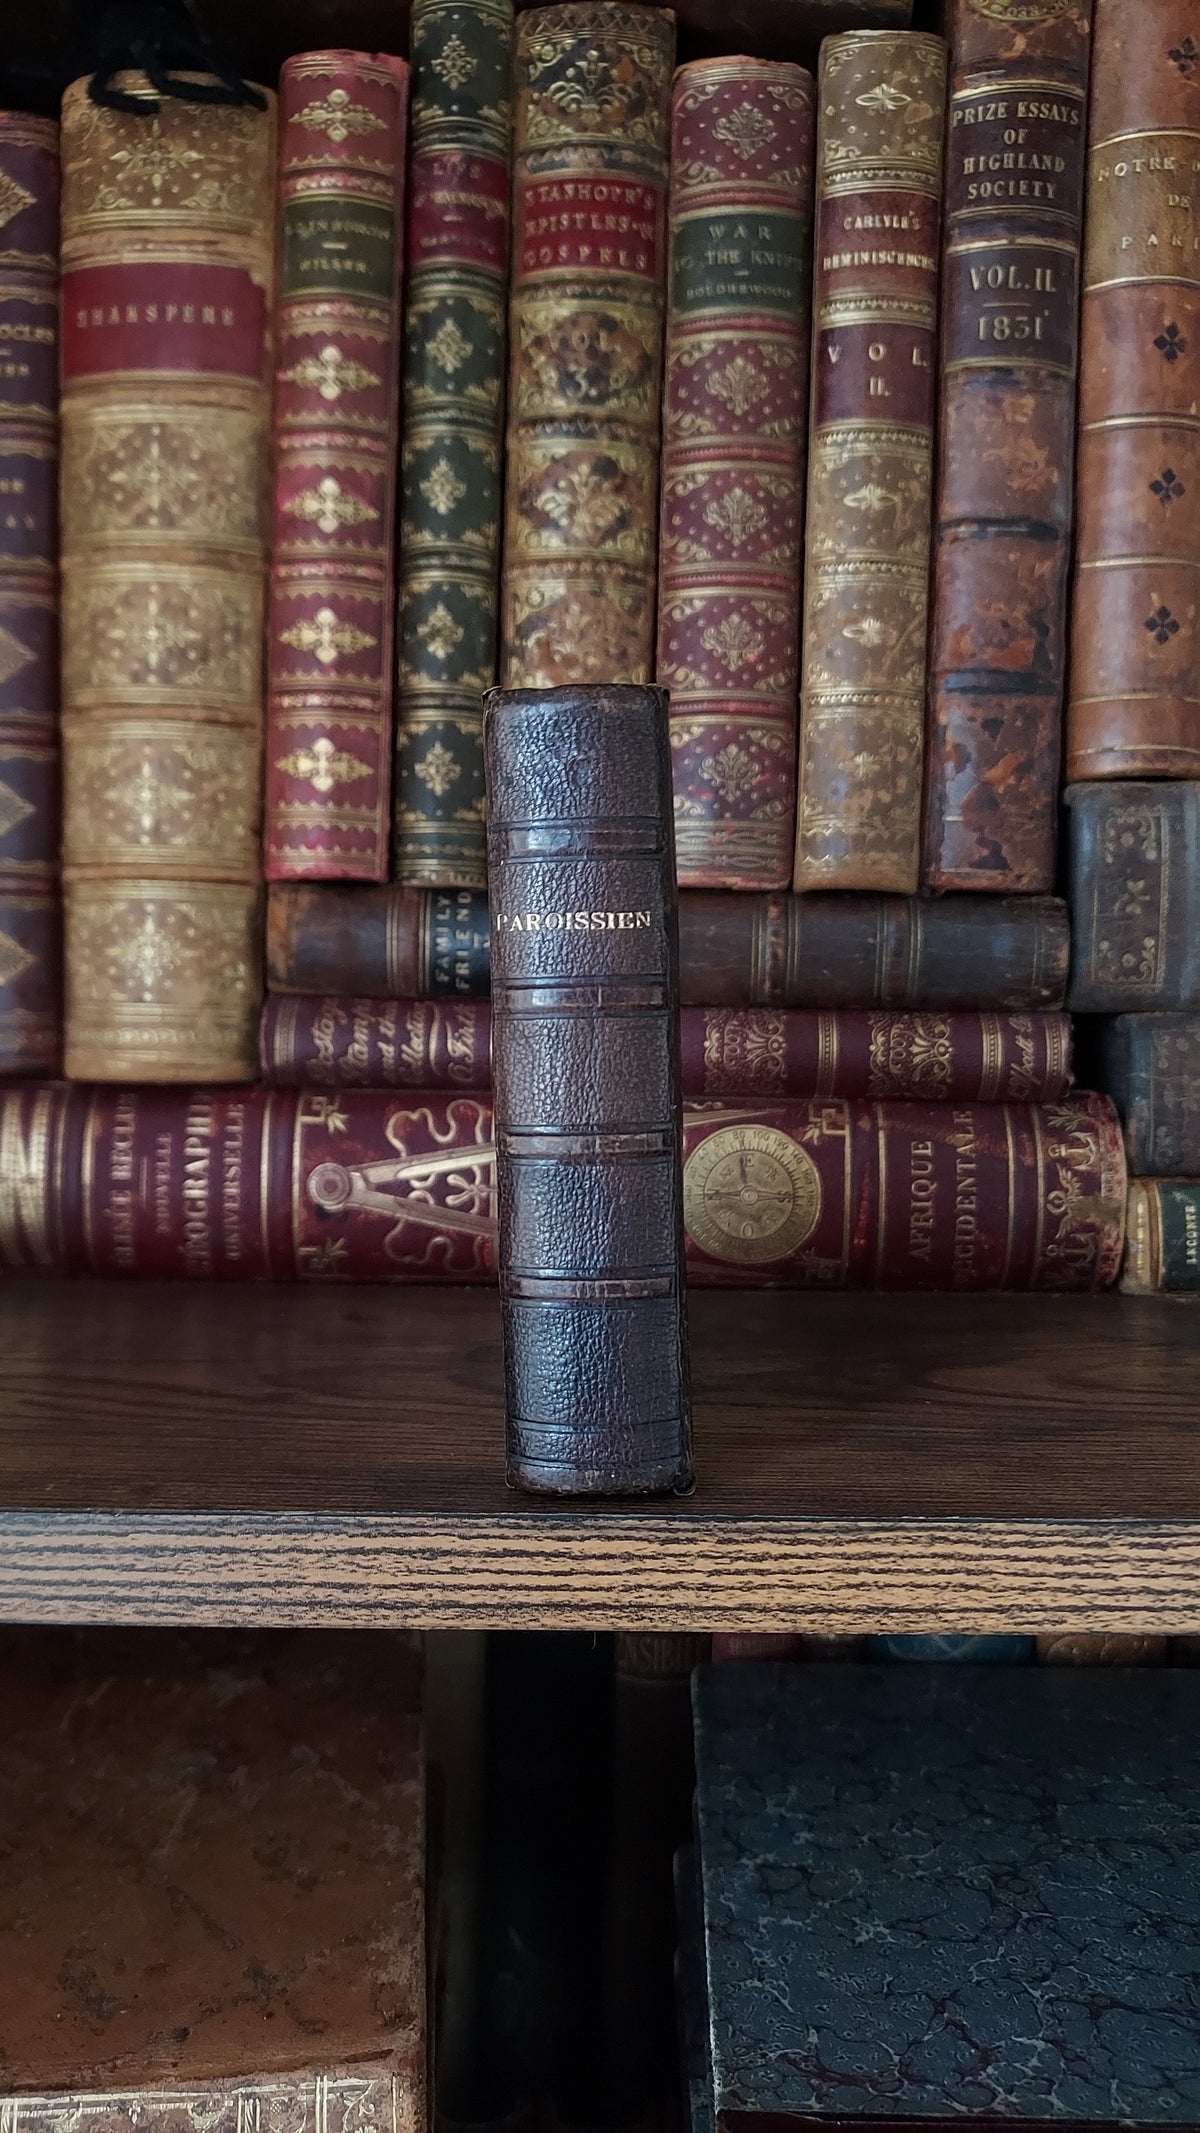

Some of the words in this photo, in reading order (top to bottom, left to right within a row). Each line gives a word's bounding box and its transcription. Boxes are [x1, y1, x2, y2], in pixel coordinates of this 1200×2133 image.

[952, 102, 1008, 128] PRIZE
[1017, 101, 1079, 126] ESSAYS
[1003, 128, 1028, 145] OF
[962, 152, 1065, 175] HIGHLAND
[967, 179, 1057, 200] SOCIETY
[1168, 194, 1191, 208] DE
[843, 211, 921, 231] CARLYLE'S
[708, 223, 770, 241] WAR
[704, 248, 741, 265] THE
[823, 251, 936, 272] REMINISCENCES
[828, 343, 930, 368] VOL.
[869, 376, 891, 397] II.
[496, 910, 652, 932] PAROISSIEN
[435, 895, 450, 983] FAMILY
[454, 890, 473, 991] FRIEND
[221, 1103, 245, 1261] UNIVERSELLE
[909, 1140, 939, 1263] AFRIQUE
